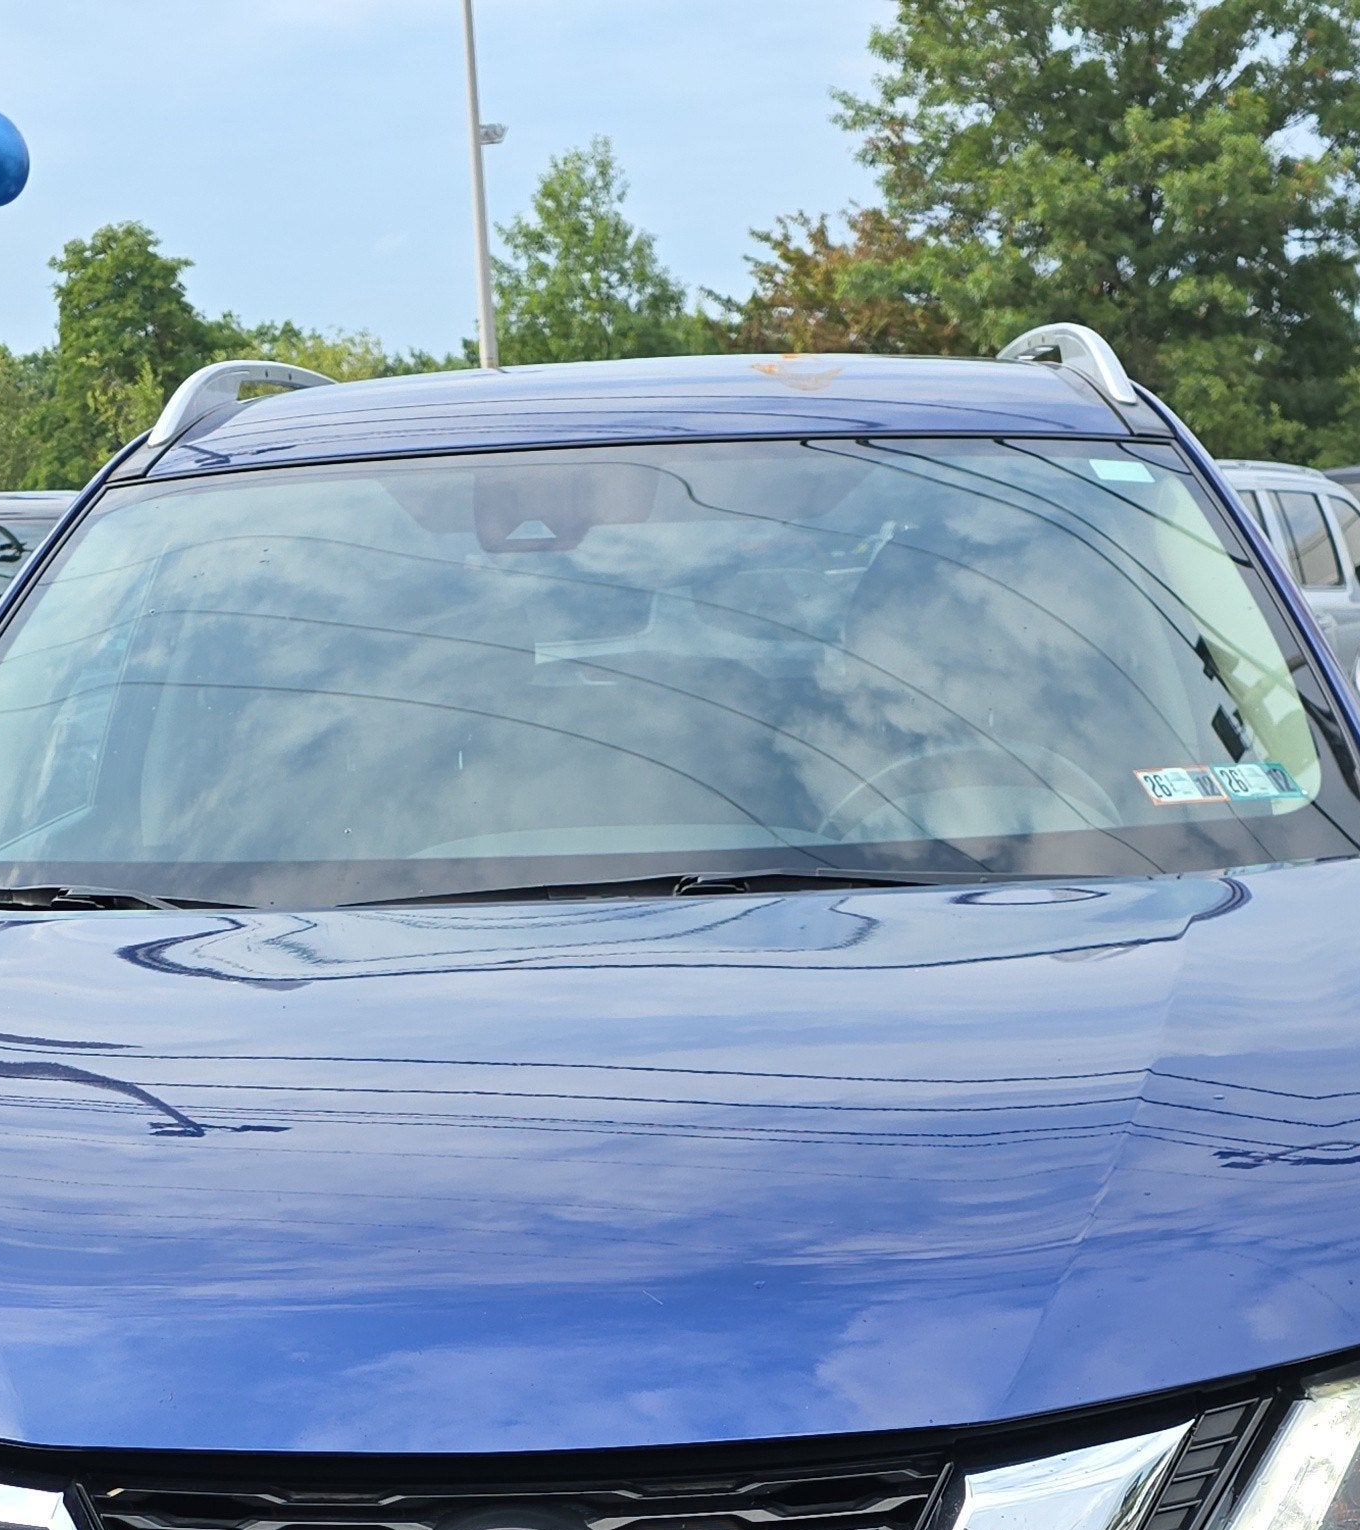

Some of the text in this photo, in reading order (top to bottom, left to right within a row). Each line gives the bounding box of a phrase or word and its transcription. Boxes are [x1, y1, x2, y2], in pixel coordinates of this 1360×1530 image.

[1143, 774, 1173, 798] 26
[1195, 775, 1223, 797] 12
[1220, 769, 1249, 794] 26
[1267, 768, 1297, 793] 12
